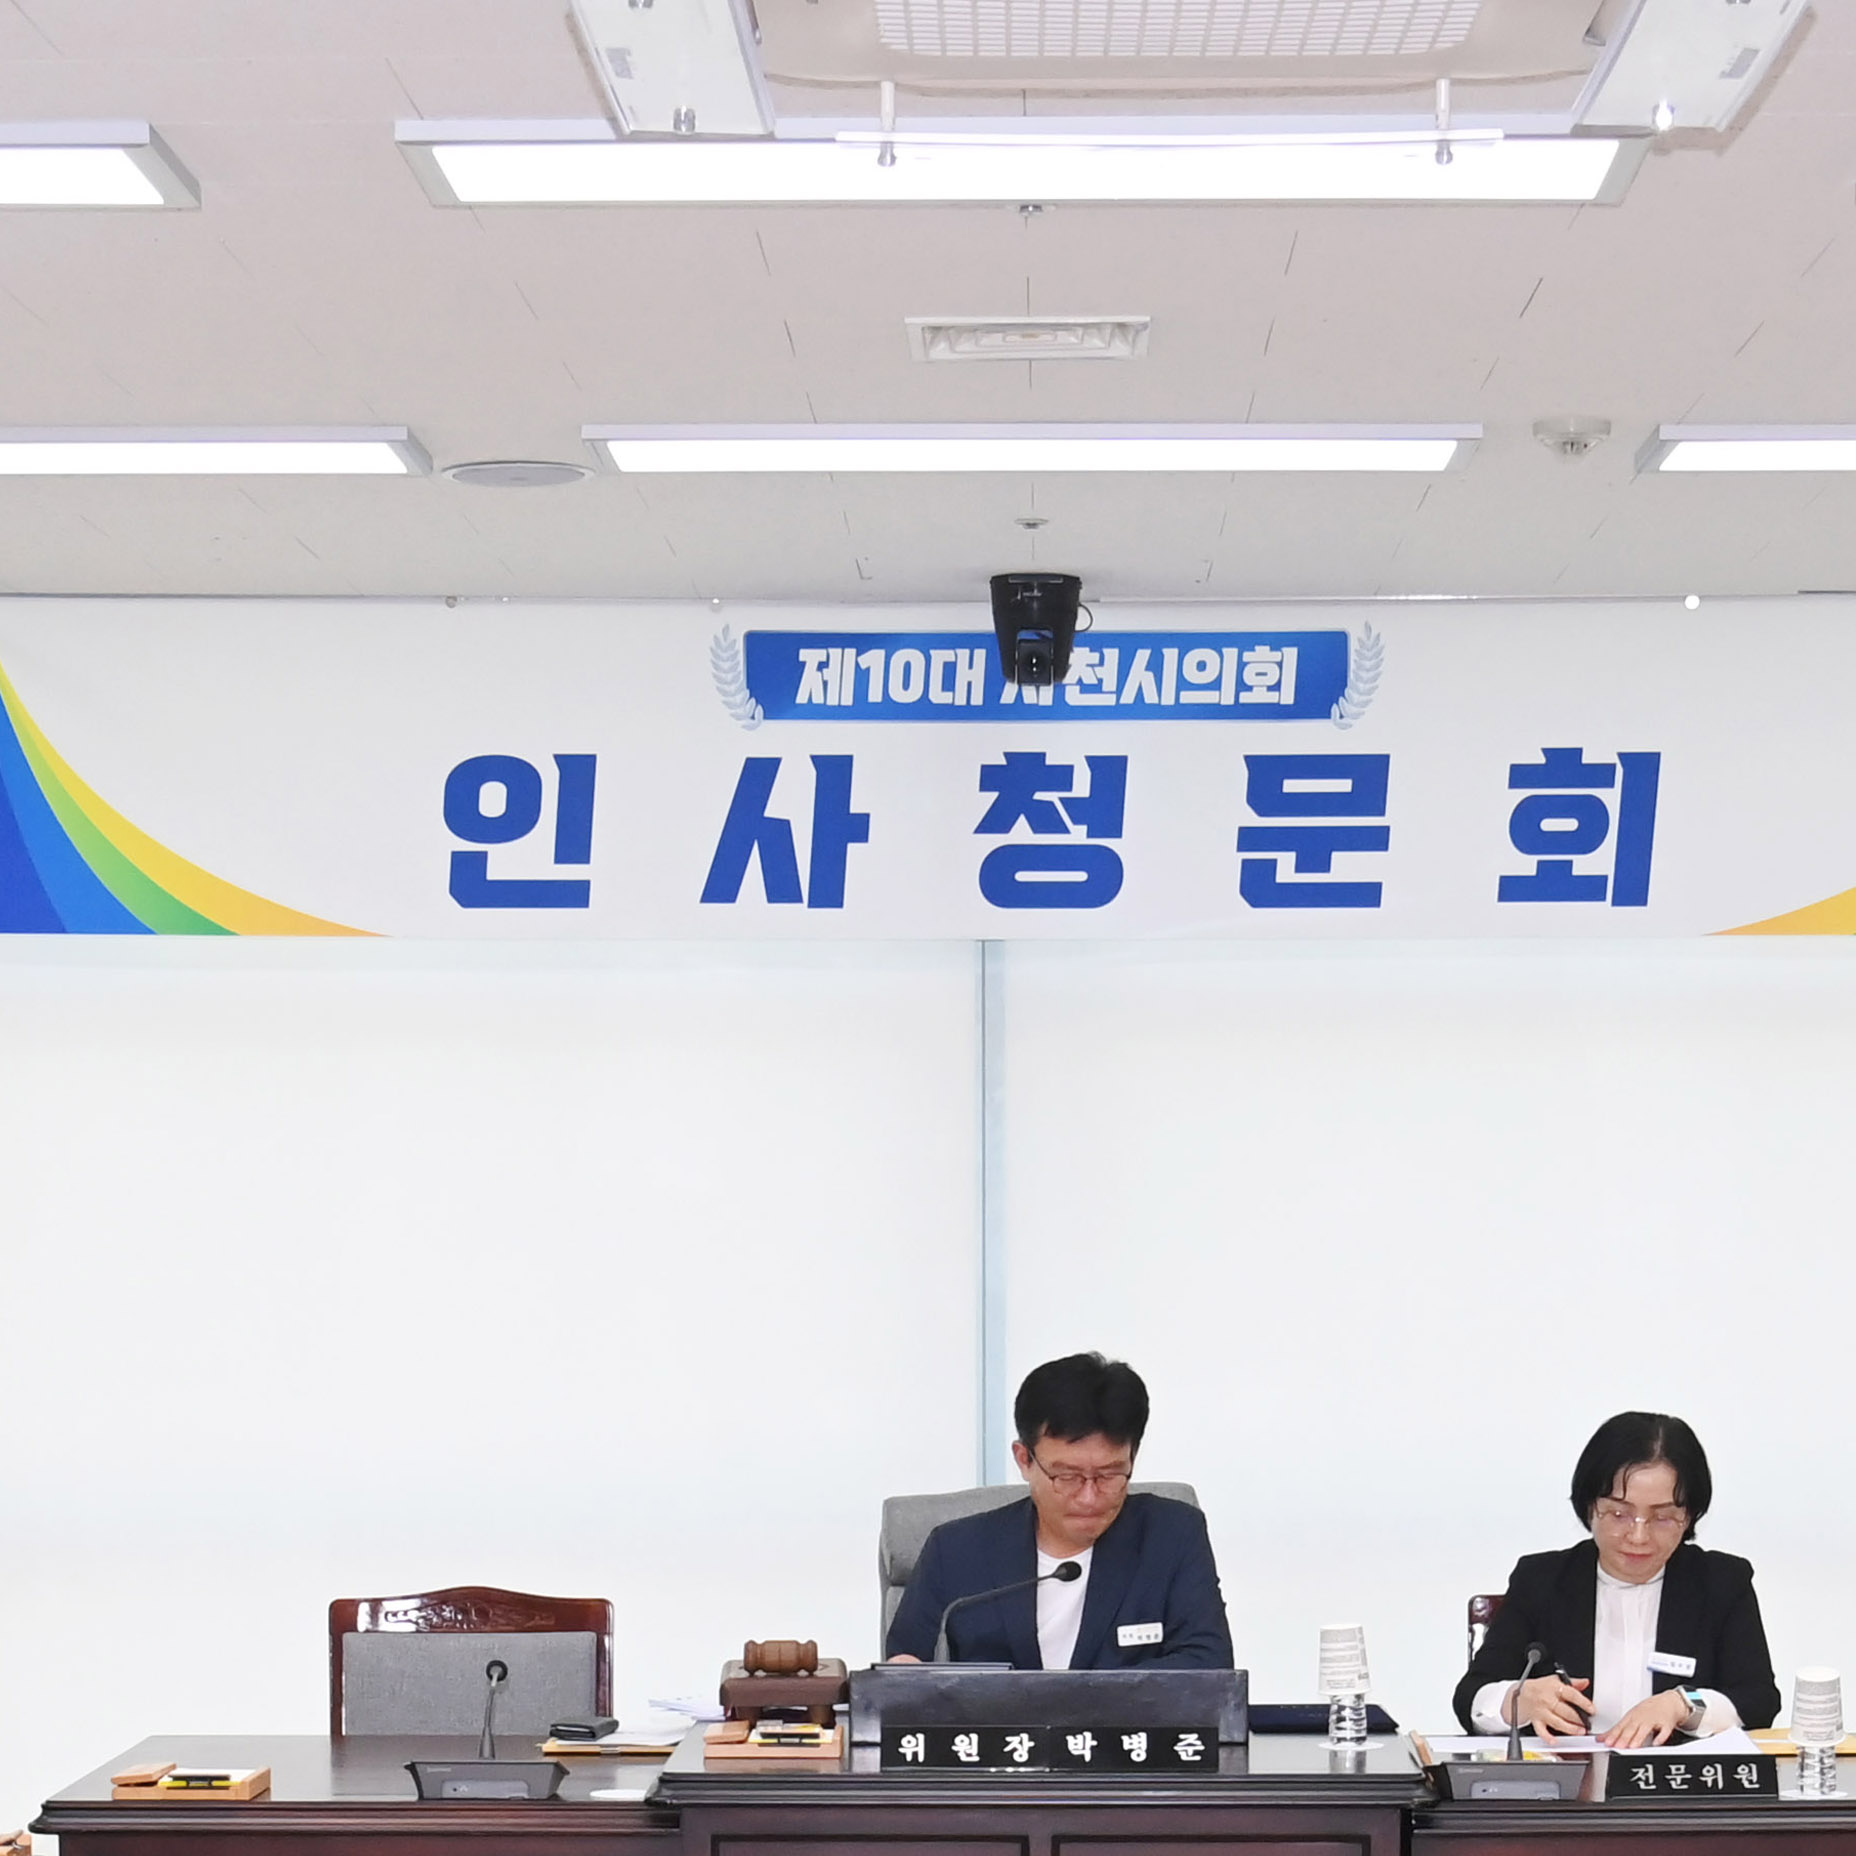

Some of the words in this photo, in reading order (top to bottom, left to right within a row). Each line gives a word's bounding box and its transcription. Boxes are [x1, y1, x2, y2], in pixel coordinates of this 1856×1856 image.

[796, 647, 986, 706] 제10대
[443, 746, 1662, 910] 인사청문회
[898, 1732, 1035, 1763] 위원장
[1066, 1731, 1206, 1763] 박병준
[1630, 1763, 1761, 1791] 전문위원
